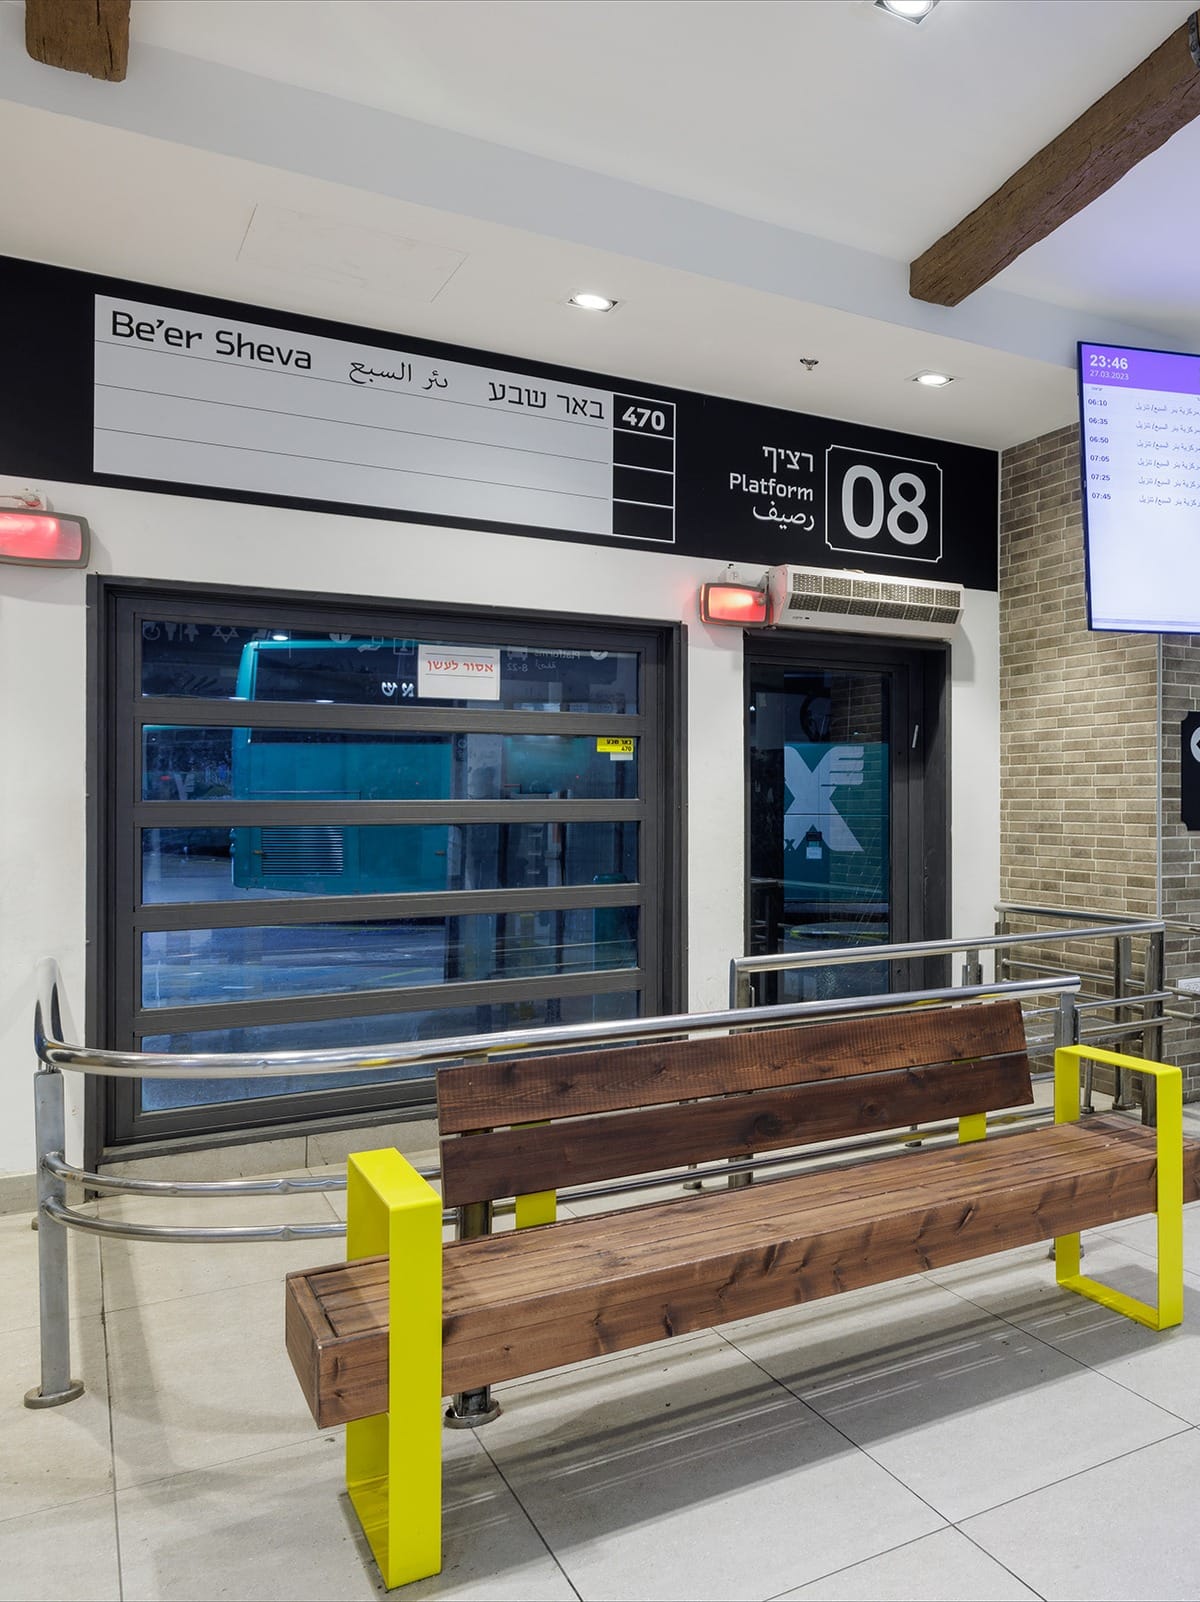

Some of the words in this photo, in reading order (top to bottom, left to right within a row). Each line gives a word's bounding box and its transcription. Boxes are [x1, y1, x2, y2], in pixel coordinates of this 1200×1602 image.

[111, 310, 203, 349] Be'er
[215, 329, 312, 370] Sheva
[349, 361, 412, 385] السبع
[1090, 354, 1128, 370] 23:46
[488, 381, 547, 410] שבע
[556, 394, 605, 420] באר
[621, 405, 667, 431] 470
[1089, 435, 1109, 444] 06:50
[762, 445, 814, 473] רציף
[1090, 454, 1110, 463] 07:05
[729, 472, 814, 502] Platform
[752, 500, 815, 531] رصيف
[841, 464, 929, 545] 08
[427, 659, 459, 671] לעשן
[462, 662, 494, 672] אסור
